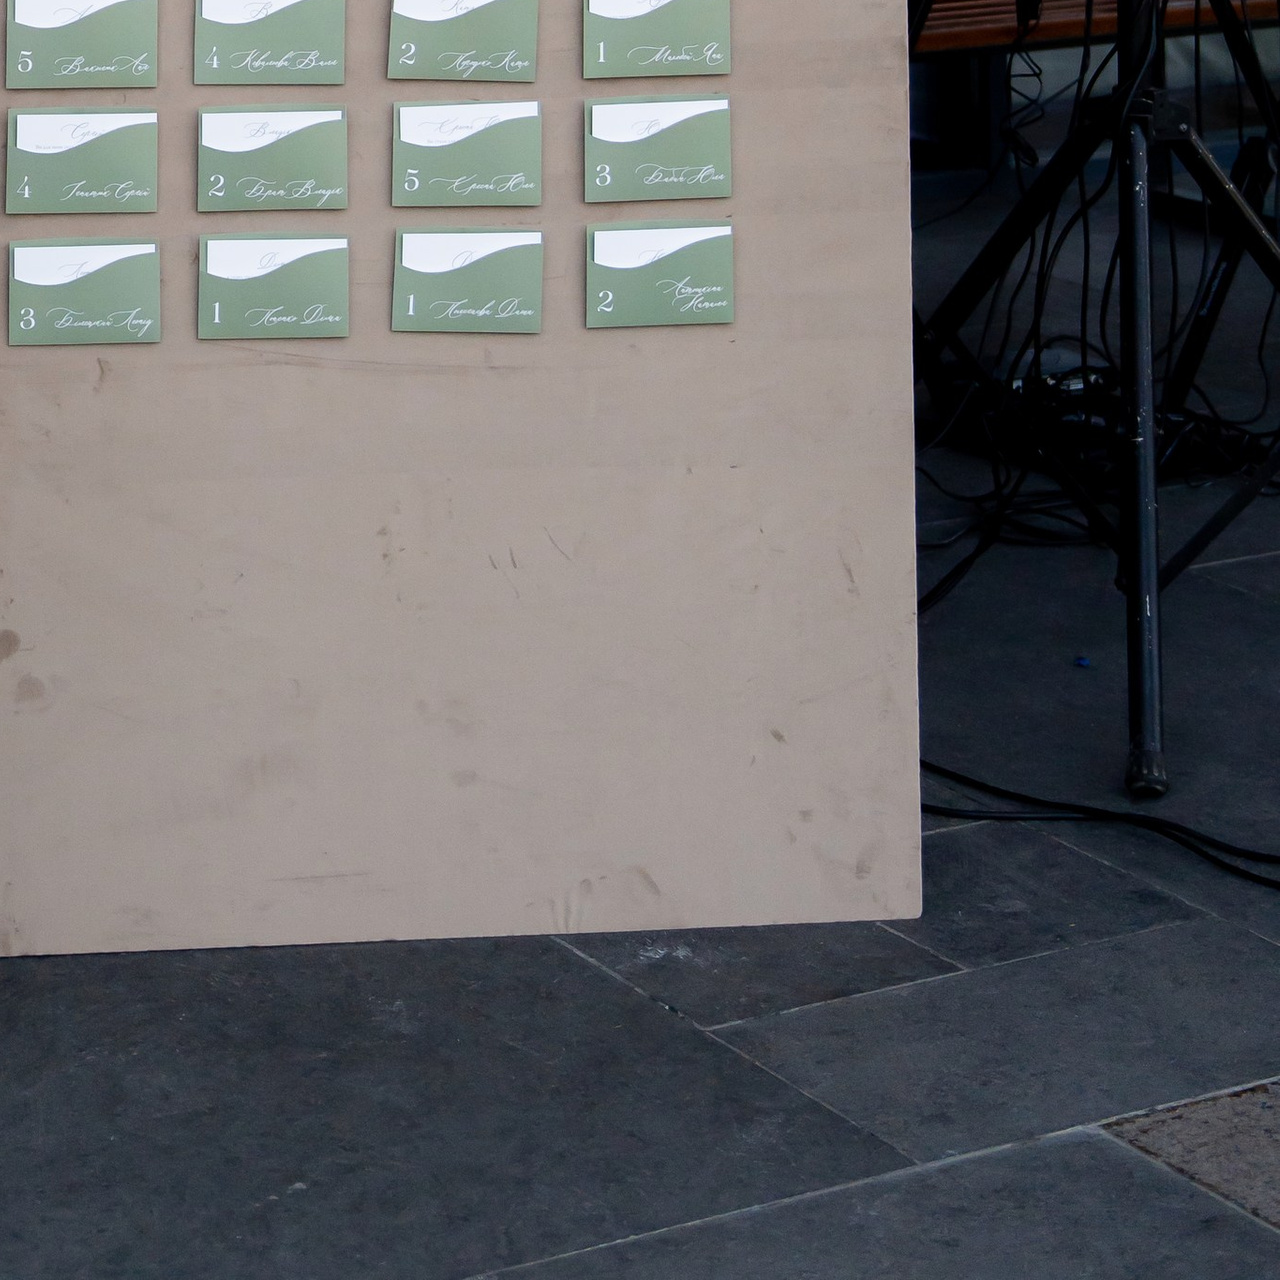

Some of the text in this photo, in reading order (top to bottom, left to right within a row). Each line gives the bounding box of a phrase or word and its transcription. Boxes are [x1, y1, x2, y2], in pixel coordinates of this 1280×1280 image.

[17, 51, 33, 73] 5
[205, 46, 221, 68] 4
[399, 42, 416, 65] 2
[596, 41, 605, 63] 1
[209, 174, 226, 196] 2
[404, 169, 419, 192] 5
[596, 164, 611, 186] 3
[16, 176, 32, 198] 4
[406, 294, 415, 316] 1
[597, 290, 614, 312] 2
[20, 307, 35, 329] 3
[212, 302, 220, 323] 1
